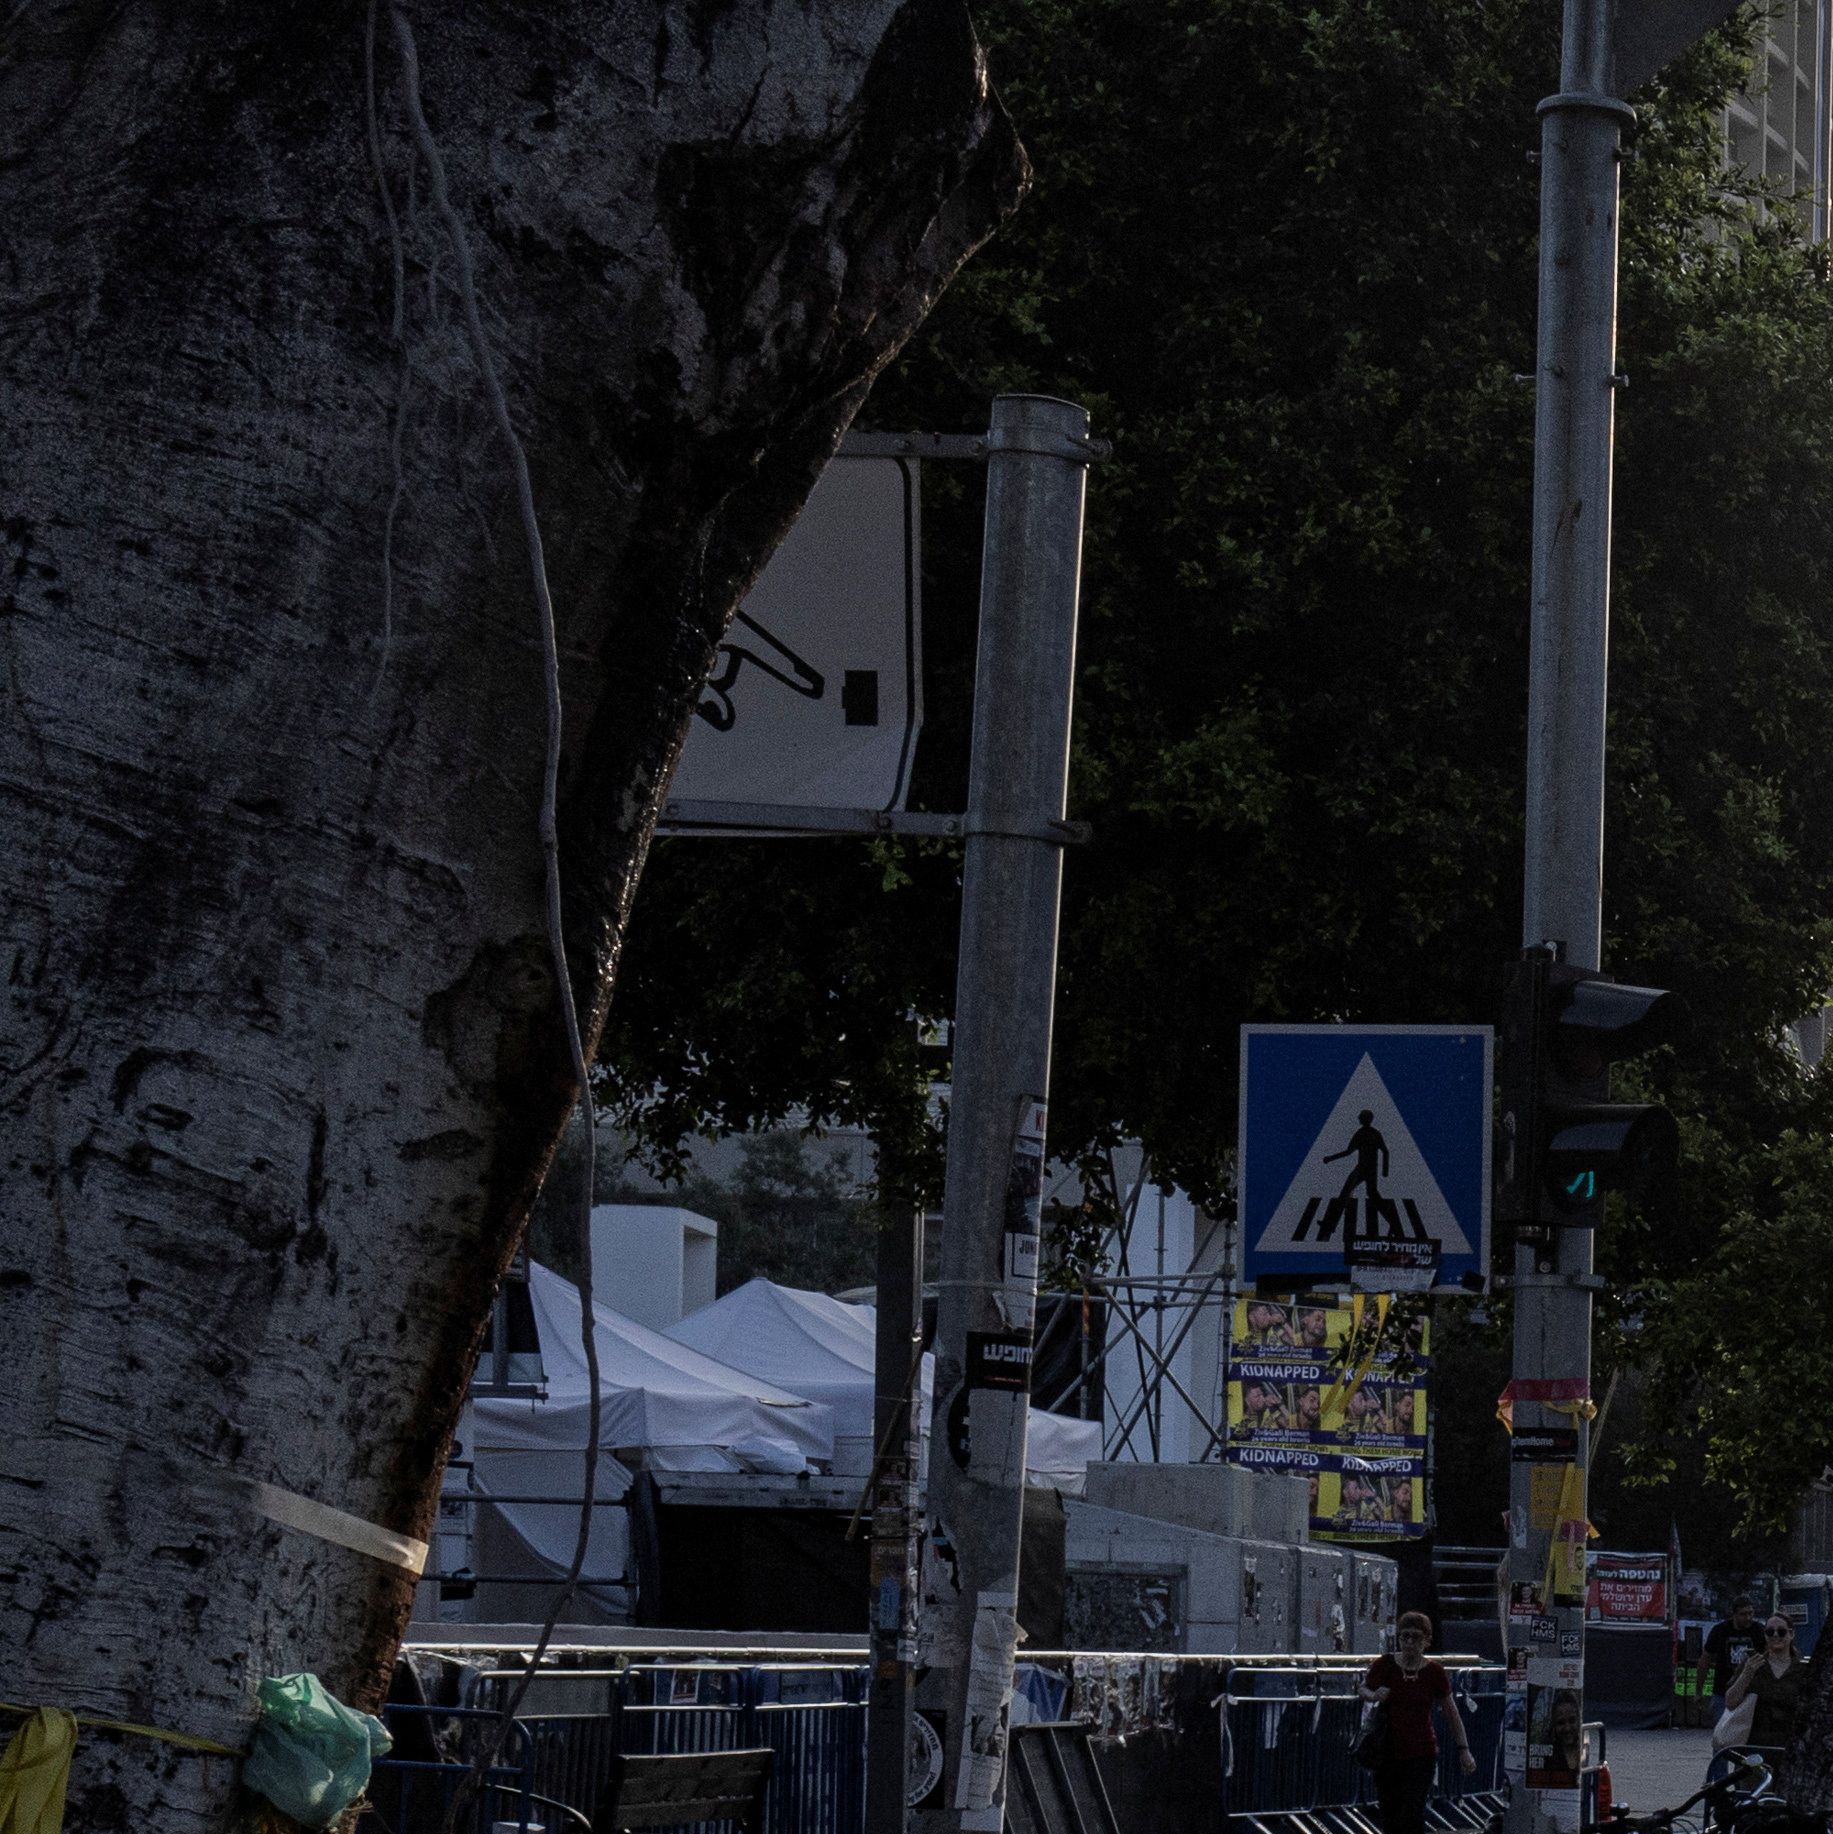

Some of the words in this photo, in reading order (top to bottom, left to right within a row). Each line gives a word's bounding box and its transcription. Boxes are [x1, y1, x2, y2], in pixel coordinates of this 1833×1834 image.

[1391, 1242, 1417, 1253] מחיר
[1240, 1364, 1320, 1380] KIDNAPPED
[1239, 1449, 1320, 1467] KIDNAPPED
[1618, 1569, 1661, 1580] נחטפה
[1531, 1619, 1556, 1630] FCK
[1530, 1628, 1555, 1639] HMS
[1529, 1744, 1554, 1757] BRING
